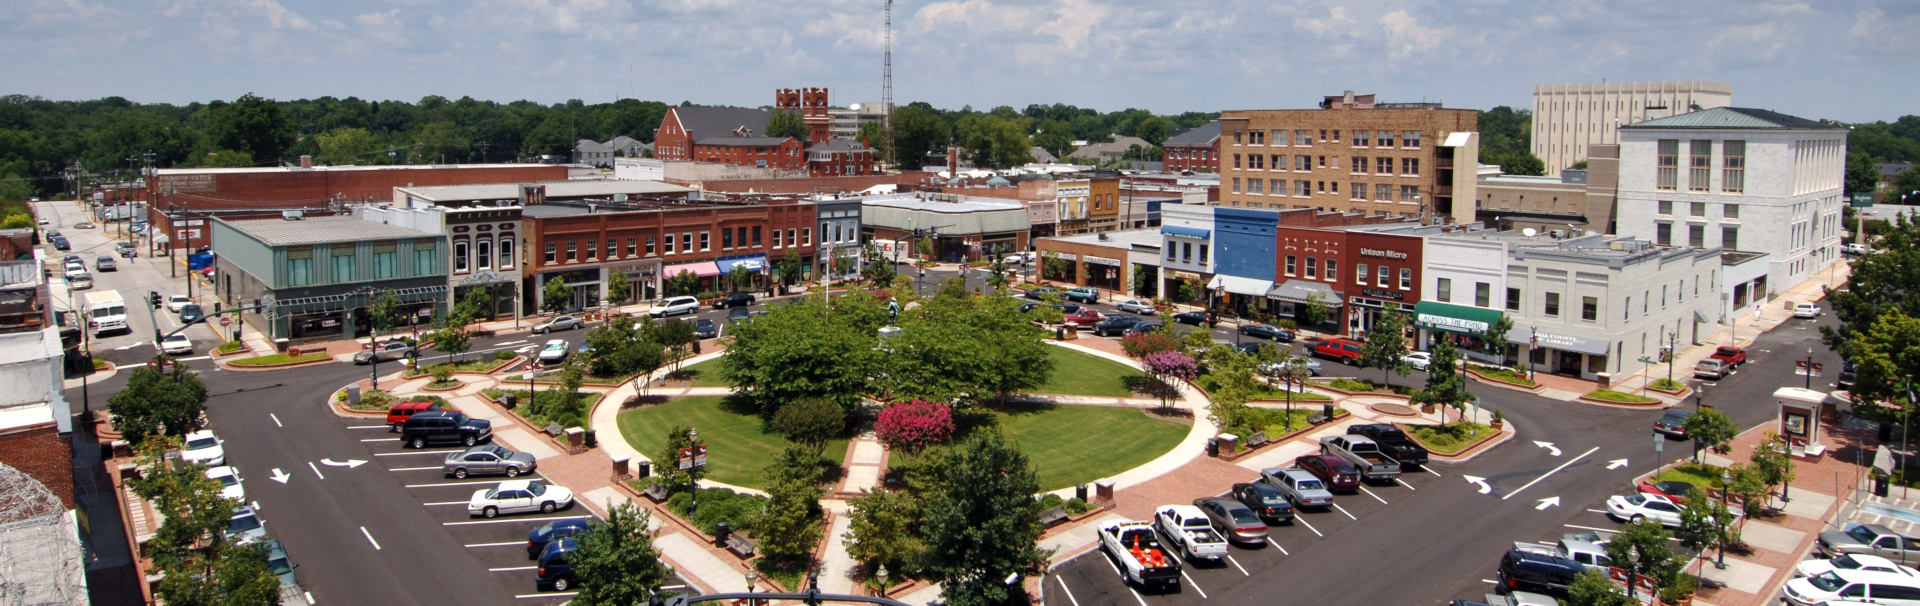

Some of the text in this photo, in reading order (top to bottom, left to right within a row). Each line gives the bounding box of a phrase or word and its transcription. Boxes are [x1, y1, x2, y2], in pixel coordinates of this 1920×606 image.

[875, 242, 892, 252] FedEx
[1360, 247, 1407, 259] Unison Micro
[1422, 315, 1448, 325] ACROSS
[1451, 318, 1463, 328] THE
[1464, 320, 1483, 330] POND
[1546, 338, 1574, 346] LIBRARY
[1549, 333, 1578, 342] COUNTY
